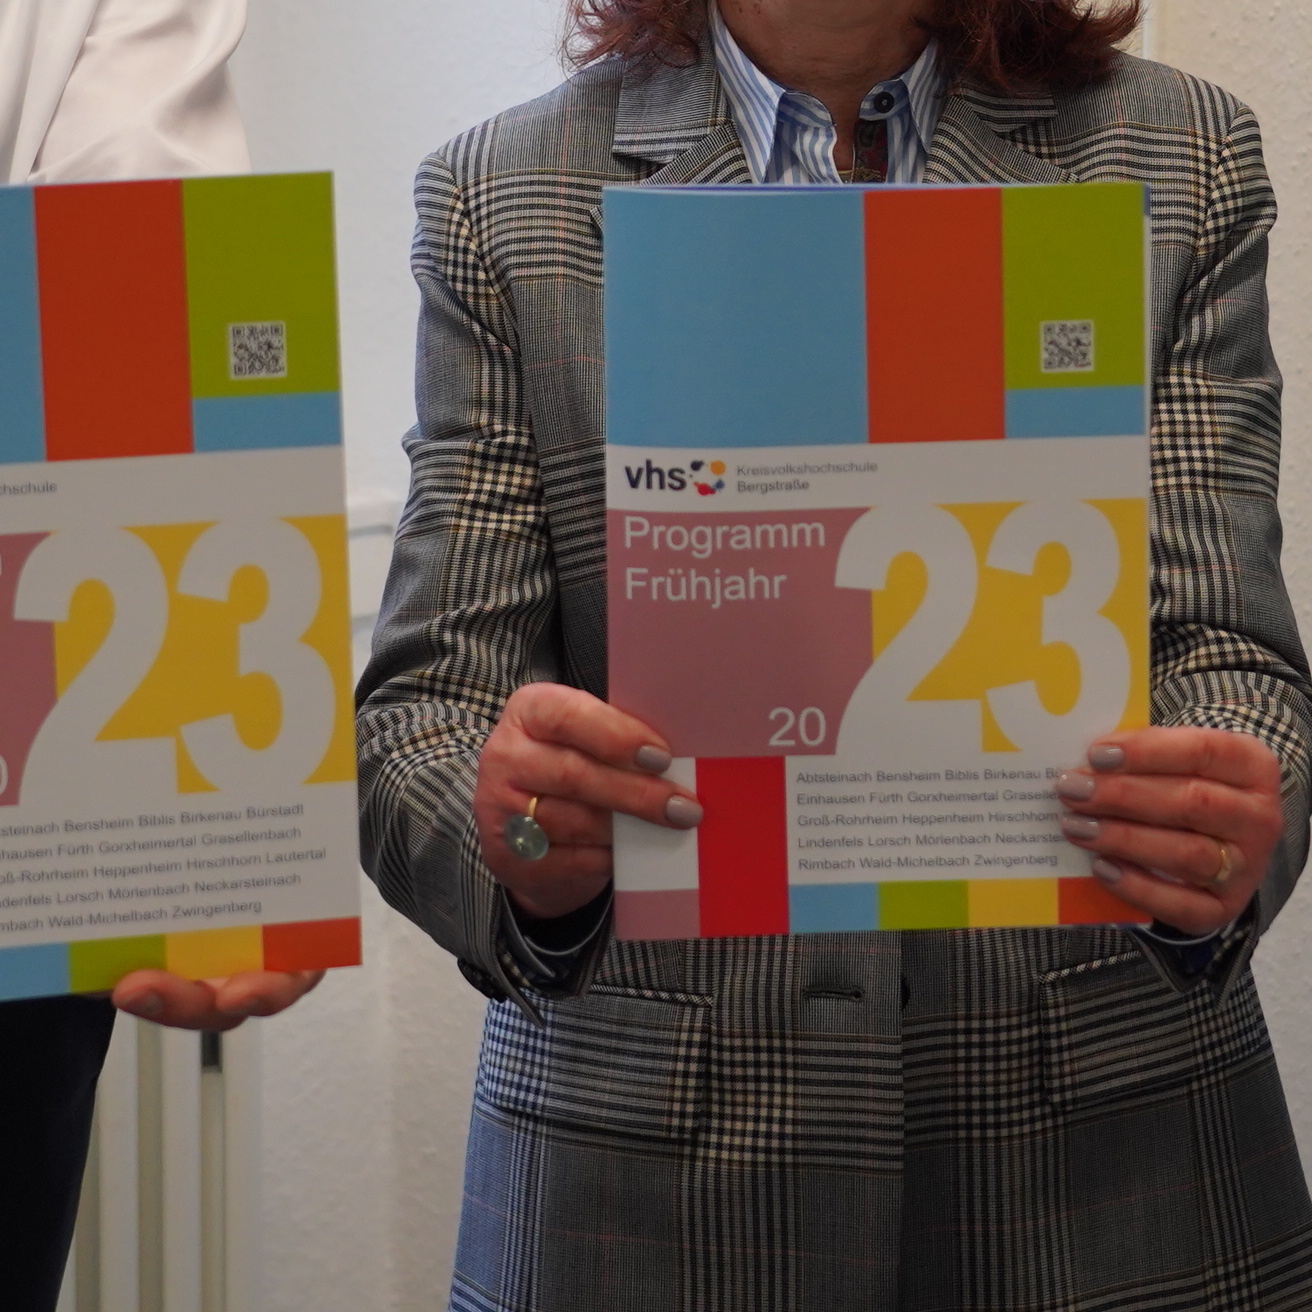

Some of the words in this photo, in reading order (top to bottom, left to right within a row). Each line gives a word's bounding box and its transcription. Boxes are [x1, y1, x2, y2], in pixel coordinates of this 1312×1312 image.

[624, 458, 687, 491] vhs
[737, 461, 879, 476] Kreisvolkshochschule
[737, 479, 810, 494] Bergstraße
[623, 515, 826, 559] Programm
[624, 567, 787, 609] Frühjahr
[767, 706, 826, 747] 20
[834, 498, 1131, 754] 23
[14, 516, 338, 800] 23
